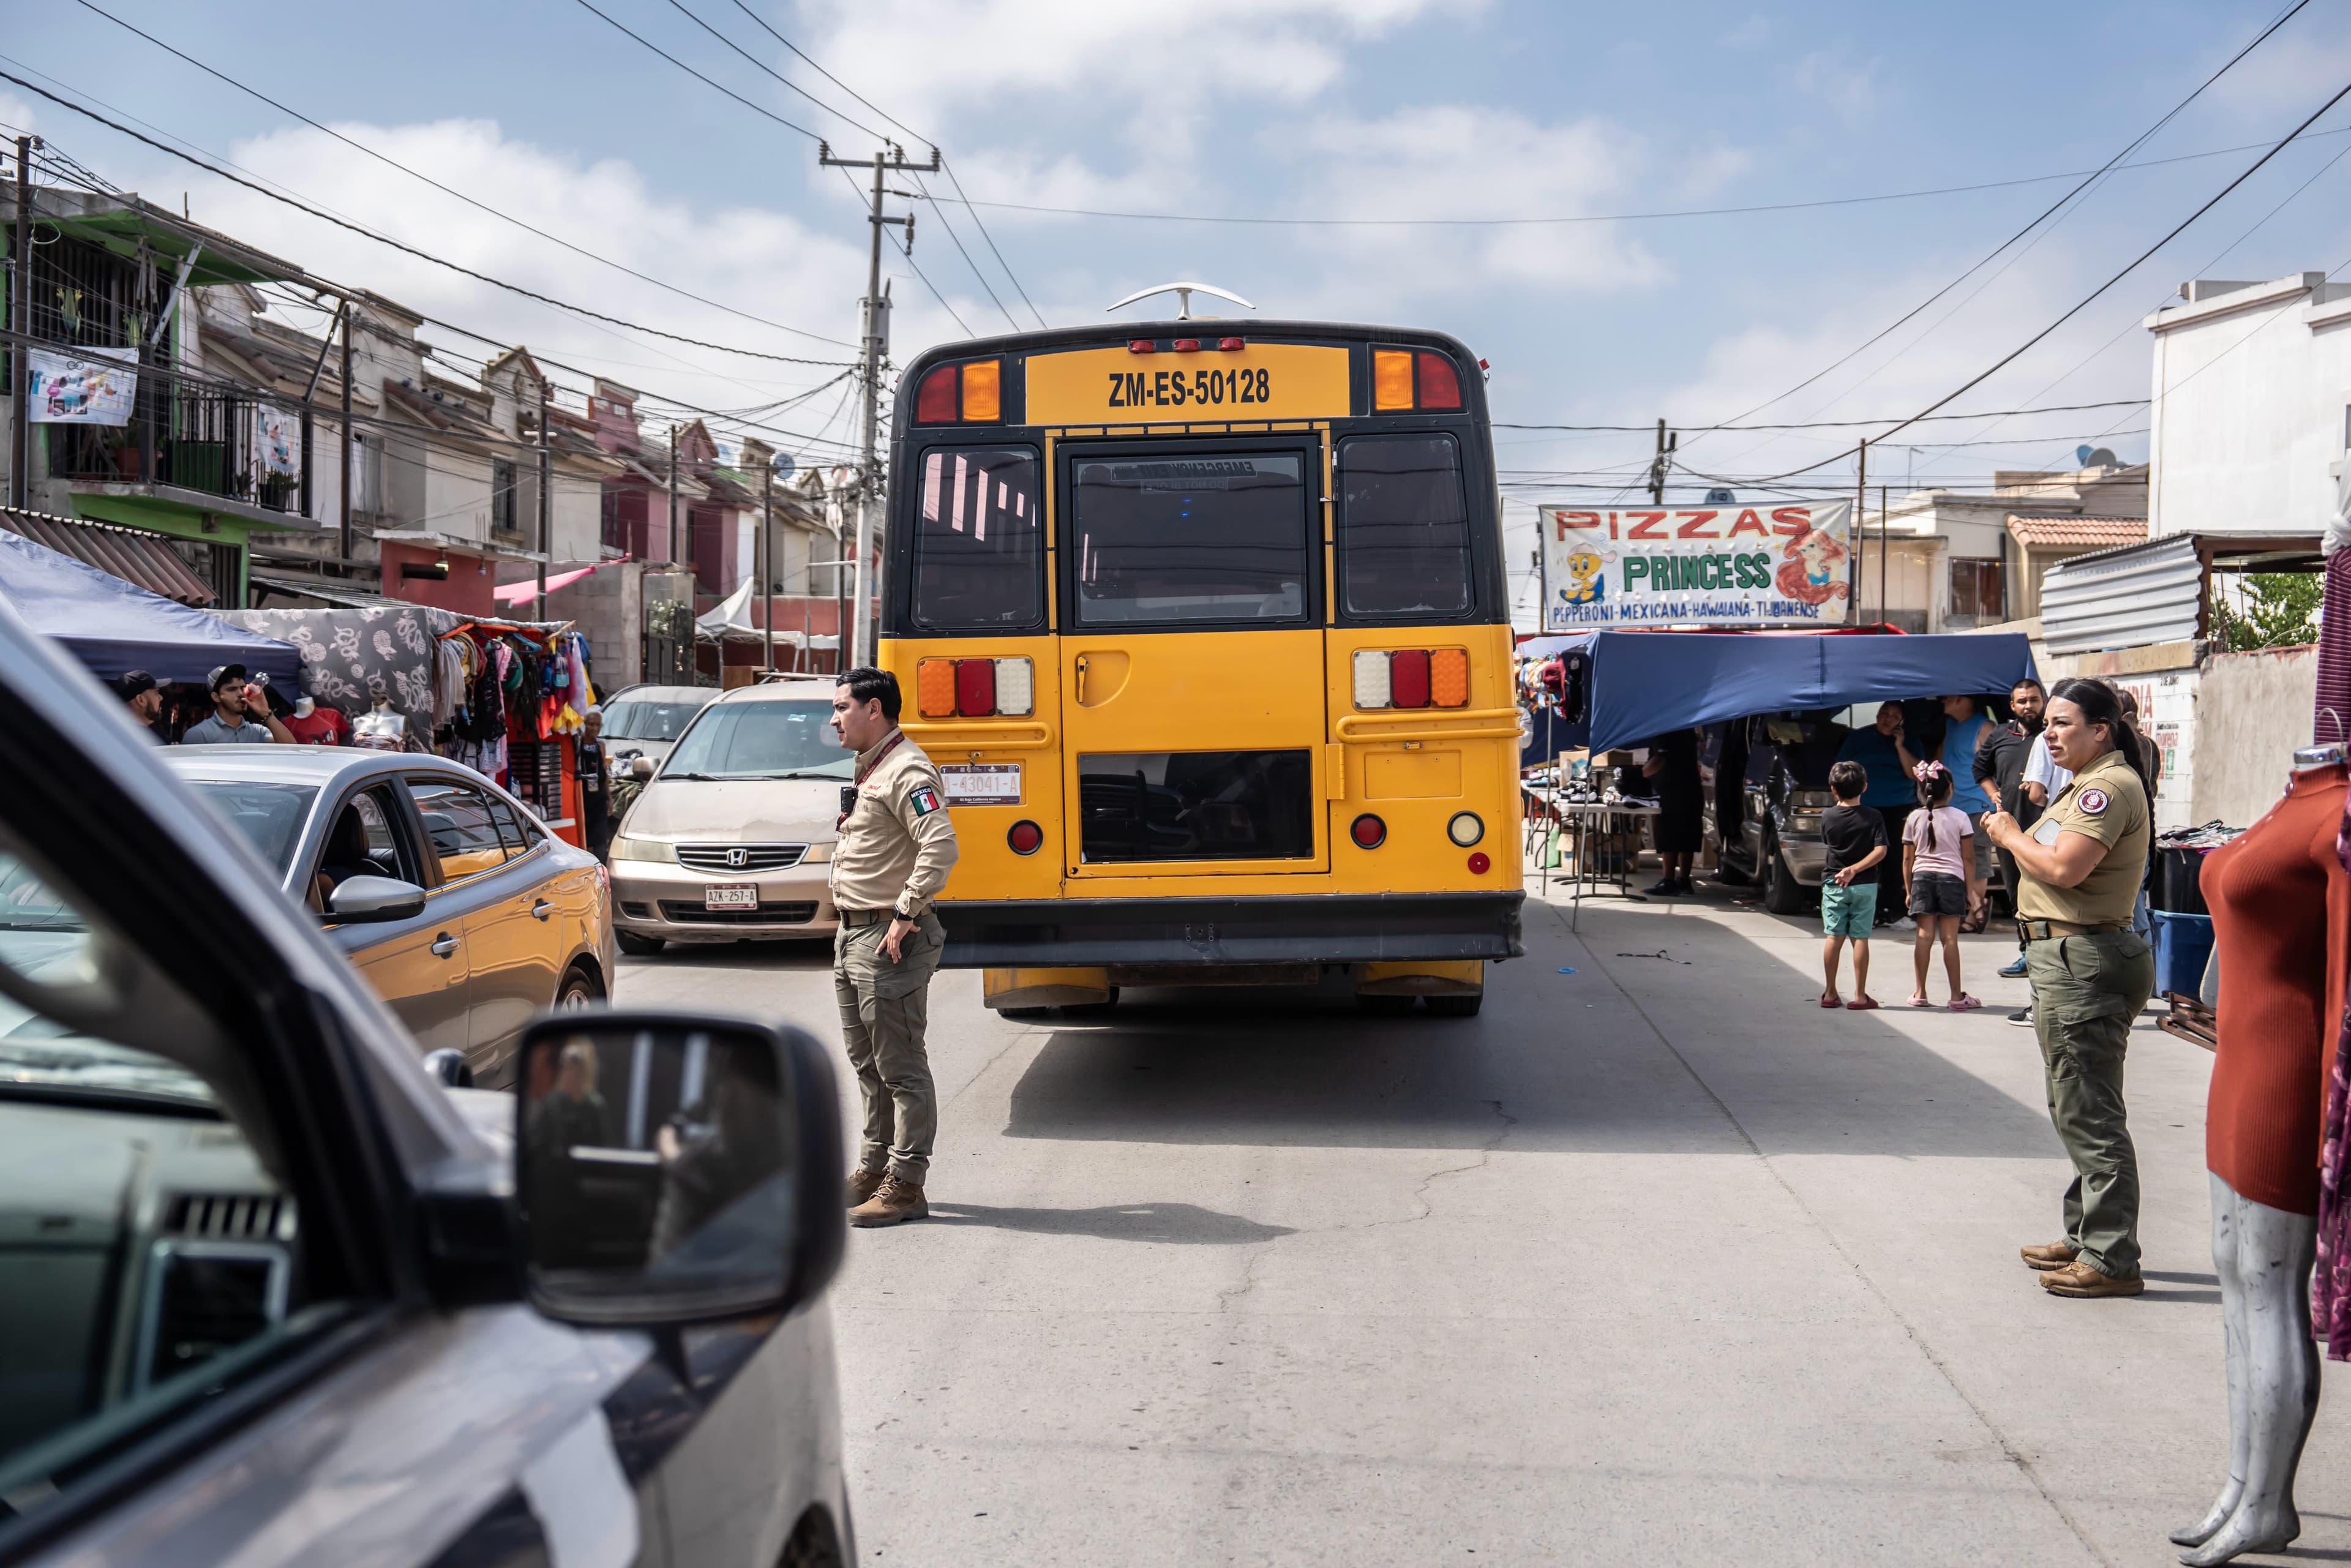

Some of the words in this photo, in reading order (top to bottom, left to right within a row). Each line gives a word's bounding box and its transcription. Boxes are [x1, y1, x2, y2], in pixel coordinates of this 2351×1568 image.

[1109, 368, 1270, 407] ZM-ES-50128
[1556, 508, 1810, 541] PIZZAS
[1622, 552, 1771, 592] PRINCESS
[911, 788, 931, 798] MEXICO
[708, 891, 754, 902] AZK-257-A
